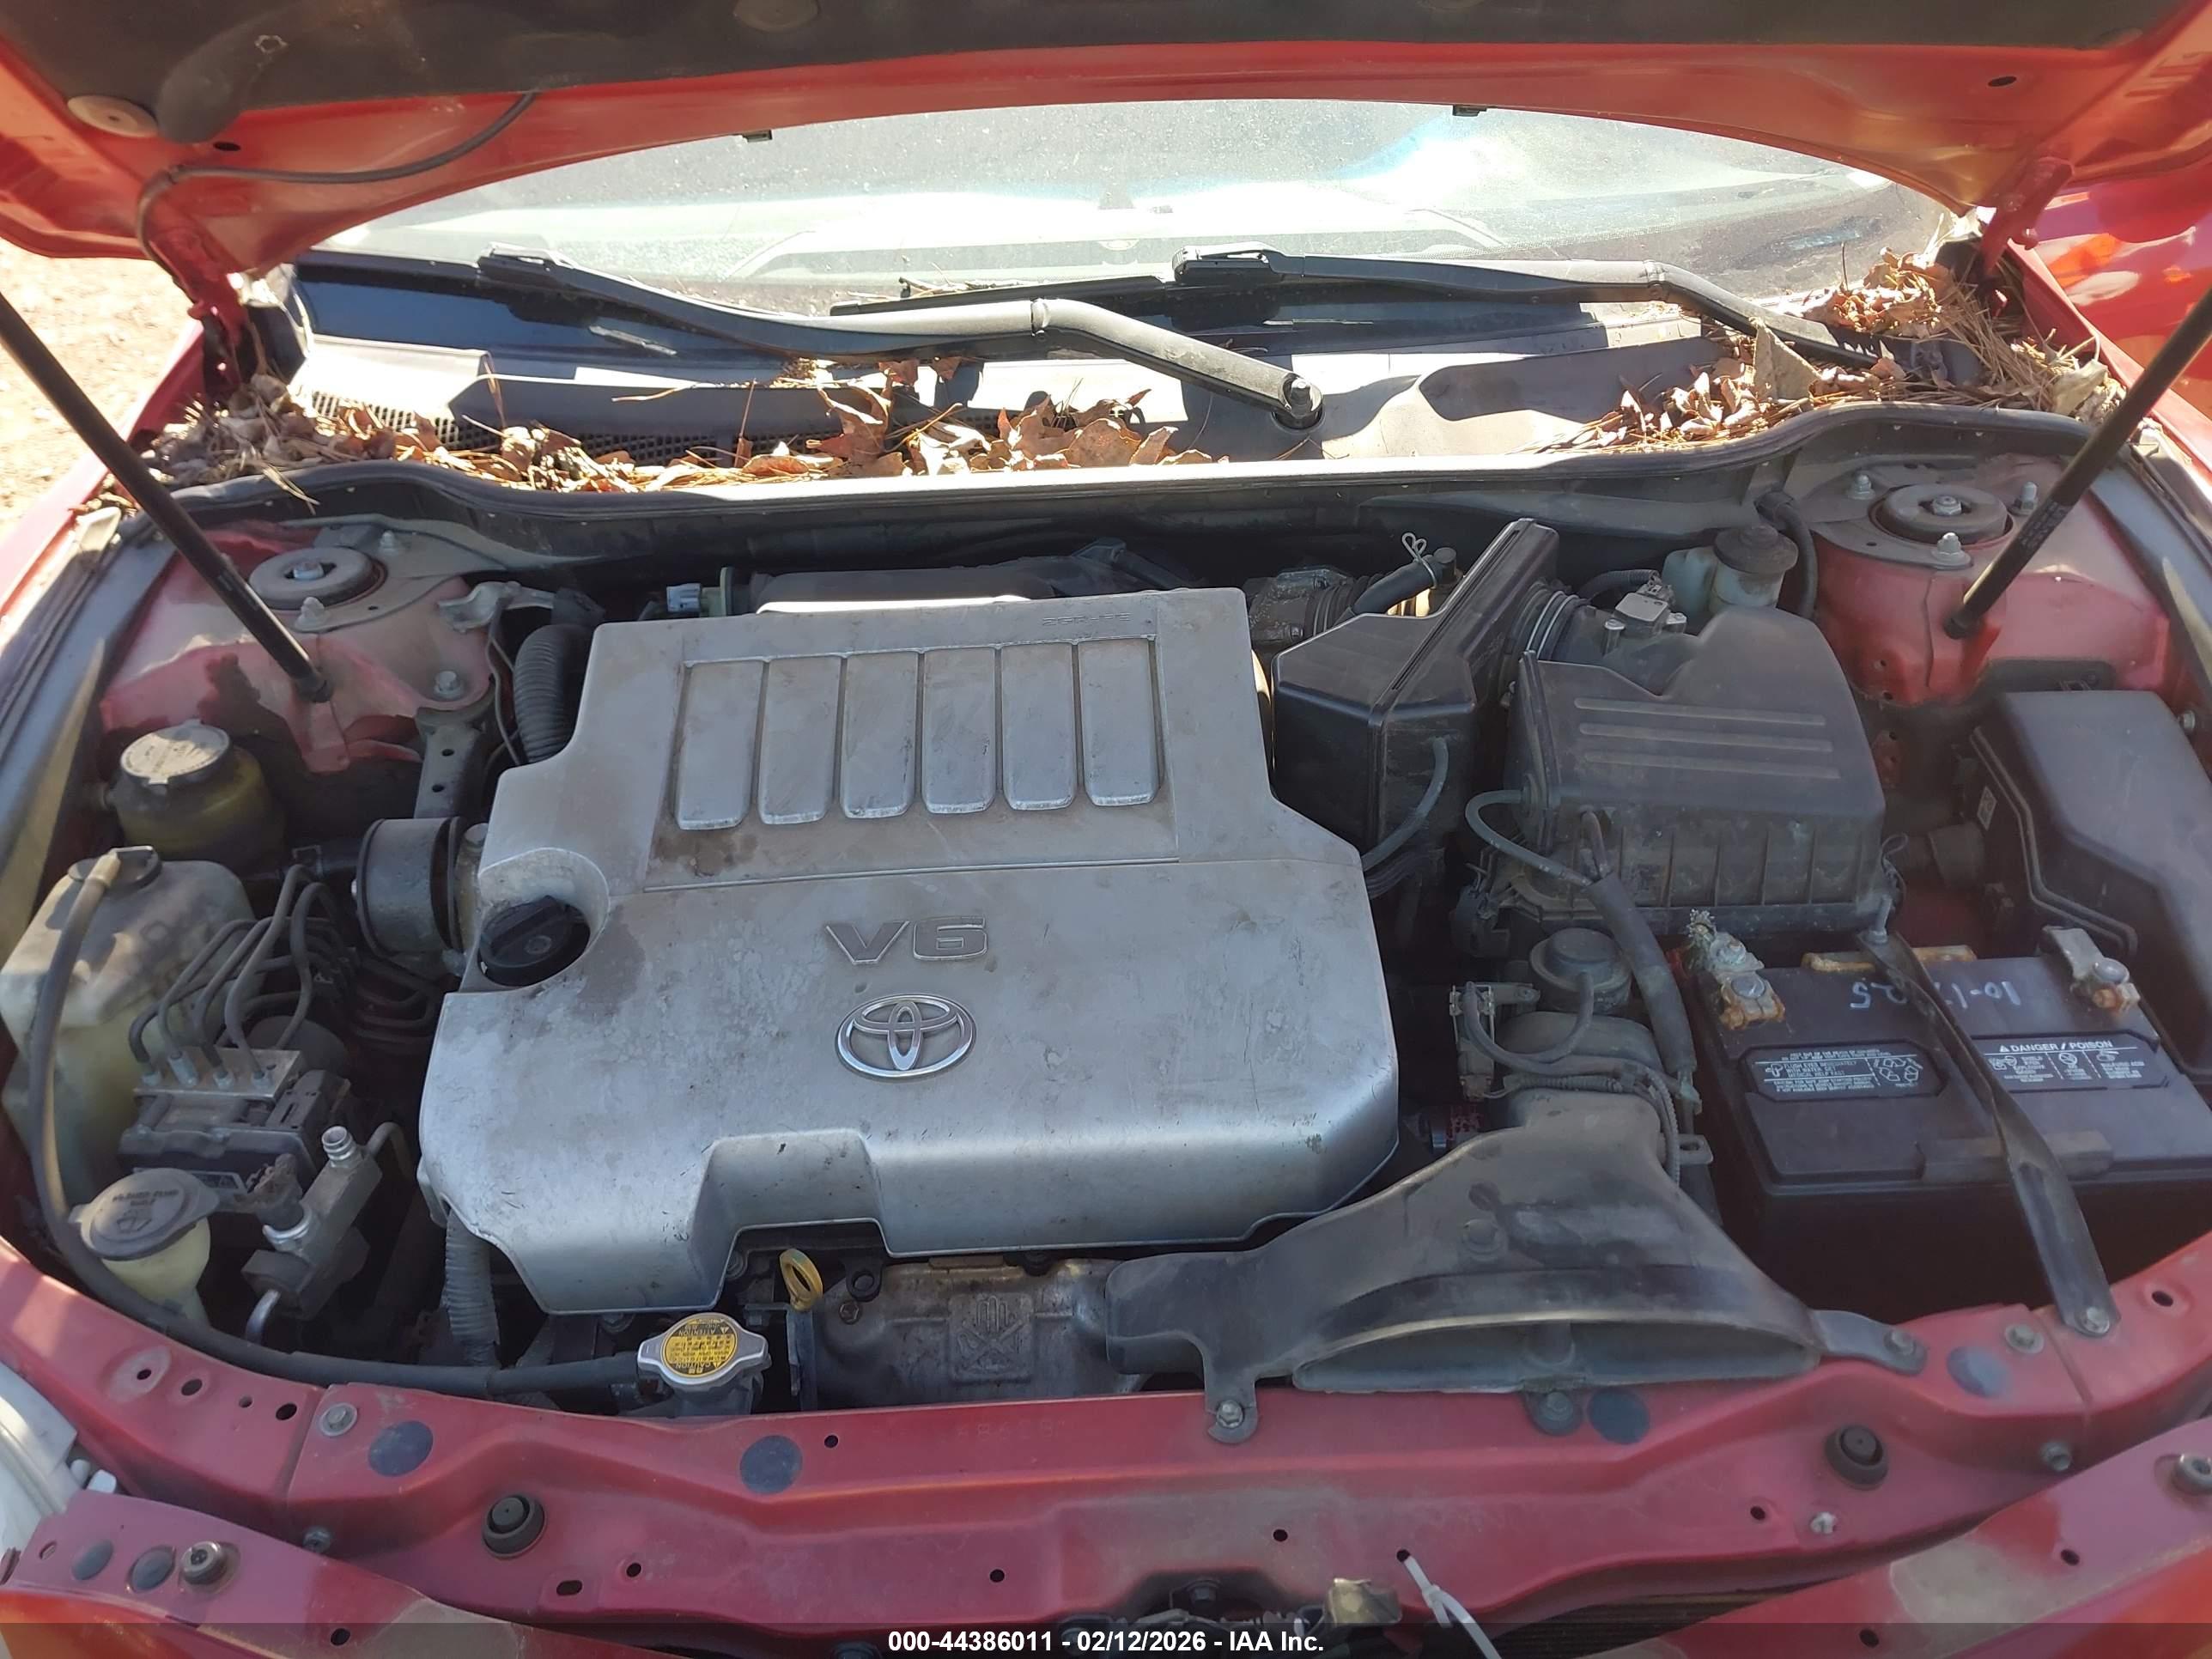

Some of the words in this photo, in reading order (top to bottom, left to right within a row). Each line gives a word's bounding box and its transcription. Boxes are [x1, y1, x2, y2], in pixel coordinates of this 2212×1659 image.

[825, 916, 988, 964] V6
[2009, 1043, 2058, 1052] DANGER
[2069, 1040, 2113, 1048] POISON
